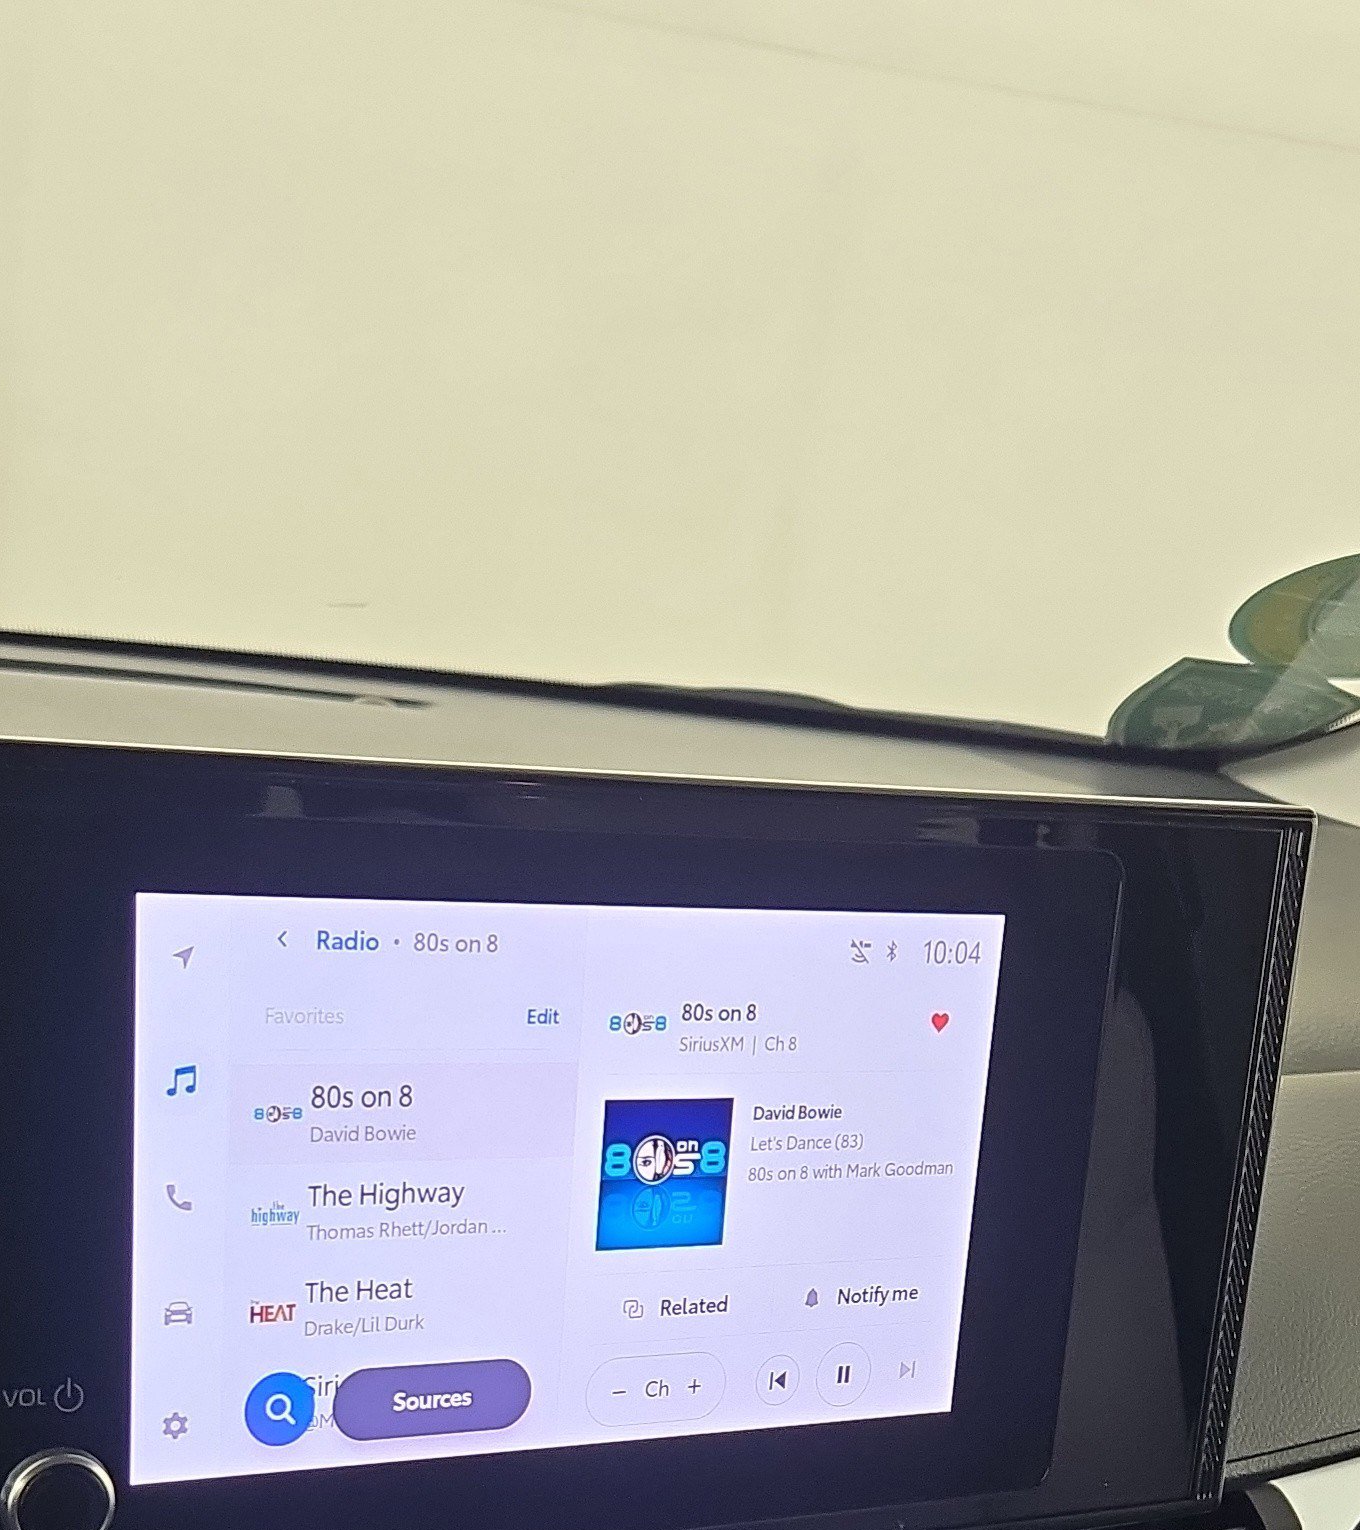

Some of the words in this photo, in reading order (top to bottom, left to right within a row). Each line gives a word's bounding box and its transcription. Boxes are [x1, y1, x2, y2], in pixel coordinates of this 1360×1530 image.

[317, 930, 380, 952] Radio
[413, 932, 450, 953] 80s
[455, 936, 482, 953] on
[486, 933, 499, 953] 8
[923, 939, 982, 965] 10:04
[265, 1007, 344, 1025] Favorites
[527, 1008, 560, 1025] Edit
[681, 1003, 714, 1022] 80s
[719, 1007, 742, 1022] on
[746, 1003, 758, 1022] 8
[679, 1036, 745, 1053] SiriusXM
[764, 1036, 785, 1052] Ch
[788, 1036, 798, 1052] 8
[311, 1085, 354, 1109] 80s
[361, 1088, 391, 1108] on
[399, 1084, 413, 1107] 8
[753, 1105, 794, 1121] David
[798, 1104, 842, 1120] Bowie
[310, 1125, 360, 1143] David
[364, 1124, 417, 1142] Bowie
[751, 1135, 784, 1151] Let's
[786, 1135, 832, 1151] Dance
[835, 1133, 864, 1151] (83)
[748, 1165, 774, 1181] 80s
[778, 1168, 797, 1181] on
[799, 1165, 809, 1180] 8
[812, 1163, 842, 1180] with
[846, 1162, 881, 1179] Mark
[884, 1161, 954, 1178] Goodman
[308, 1184, 352, 1208] The
[359, 1182, 465, 1211] Highway
[251, 1205, 300, 1226] highway
[306, 1223, 374, 1241] Thomas
[379, 1219, 488, 1239] Rhett/Jordan
[305, 1281, 349, 1303] The
[356, 1278, 413, 1302] Heat
[837, 1286, 889, 1307] Notify
[894, 1287, 919, 1302] me
[249, 1303, 297, 1324] HEAT
[660, 1295, 728, 1317] Related
[304, 1316, 380, 1337] Drake/Lil
[385, 1314, 425, 1332] Durk
[2, 1387, 47, 1408] VOL
[645, 1380, 669, 1397] Ch
[392, 1390, 472, 1412] Sources
